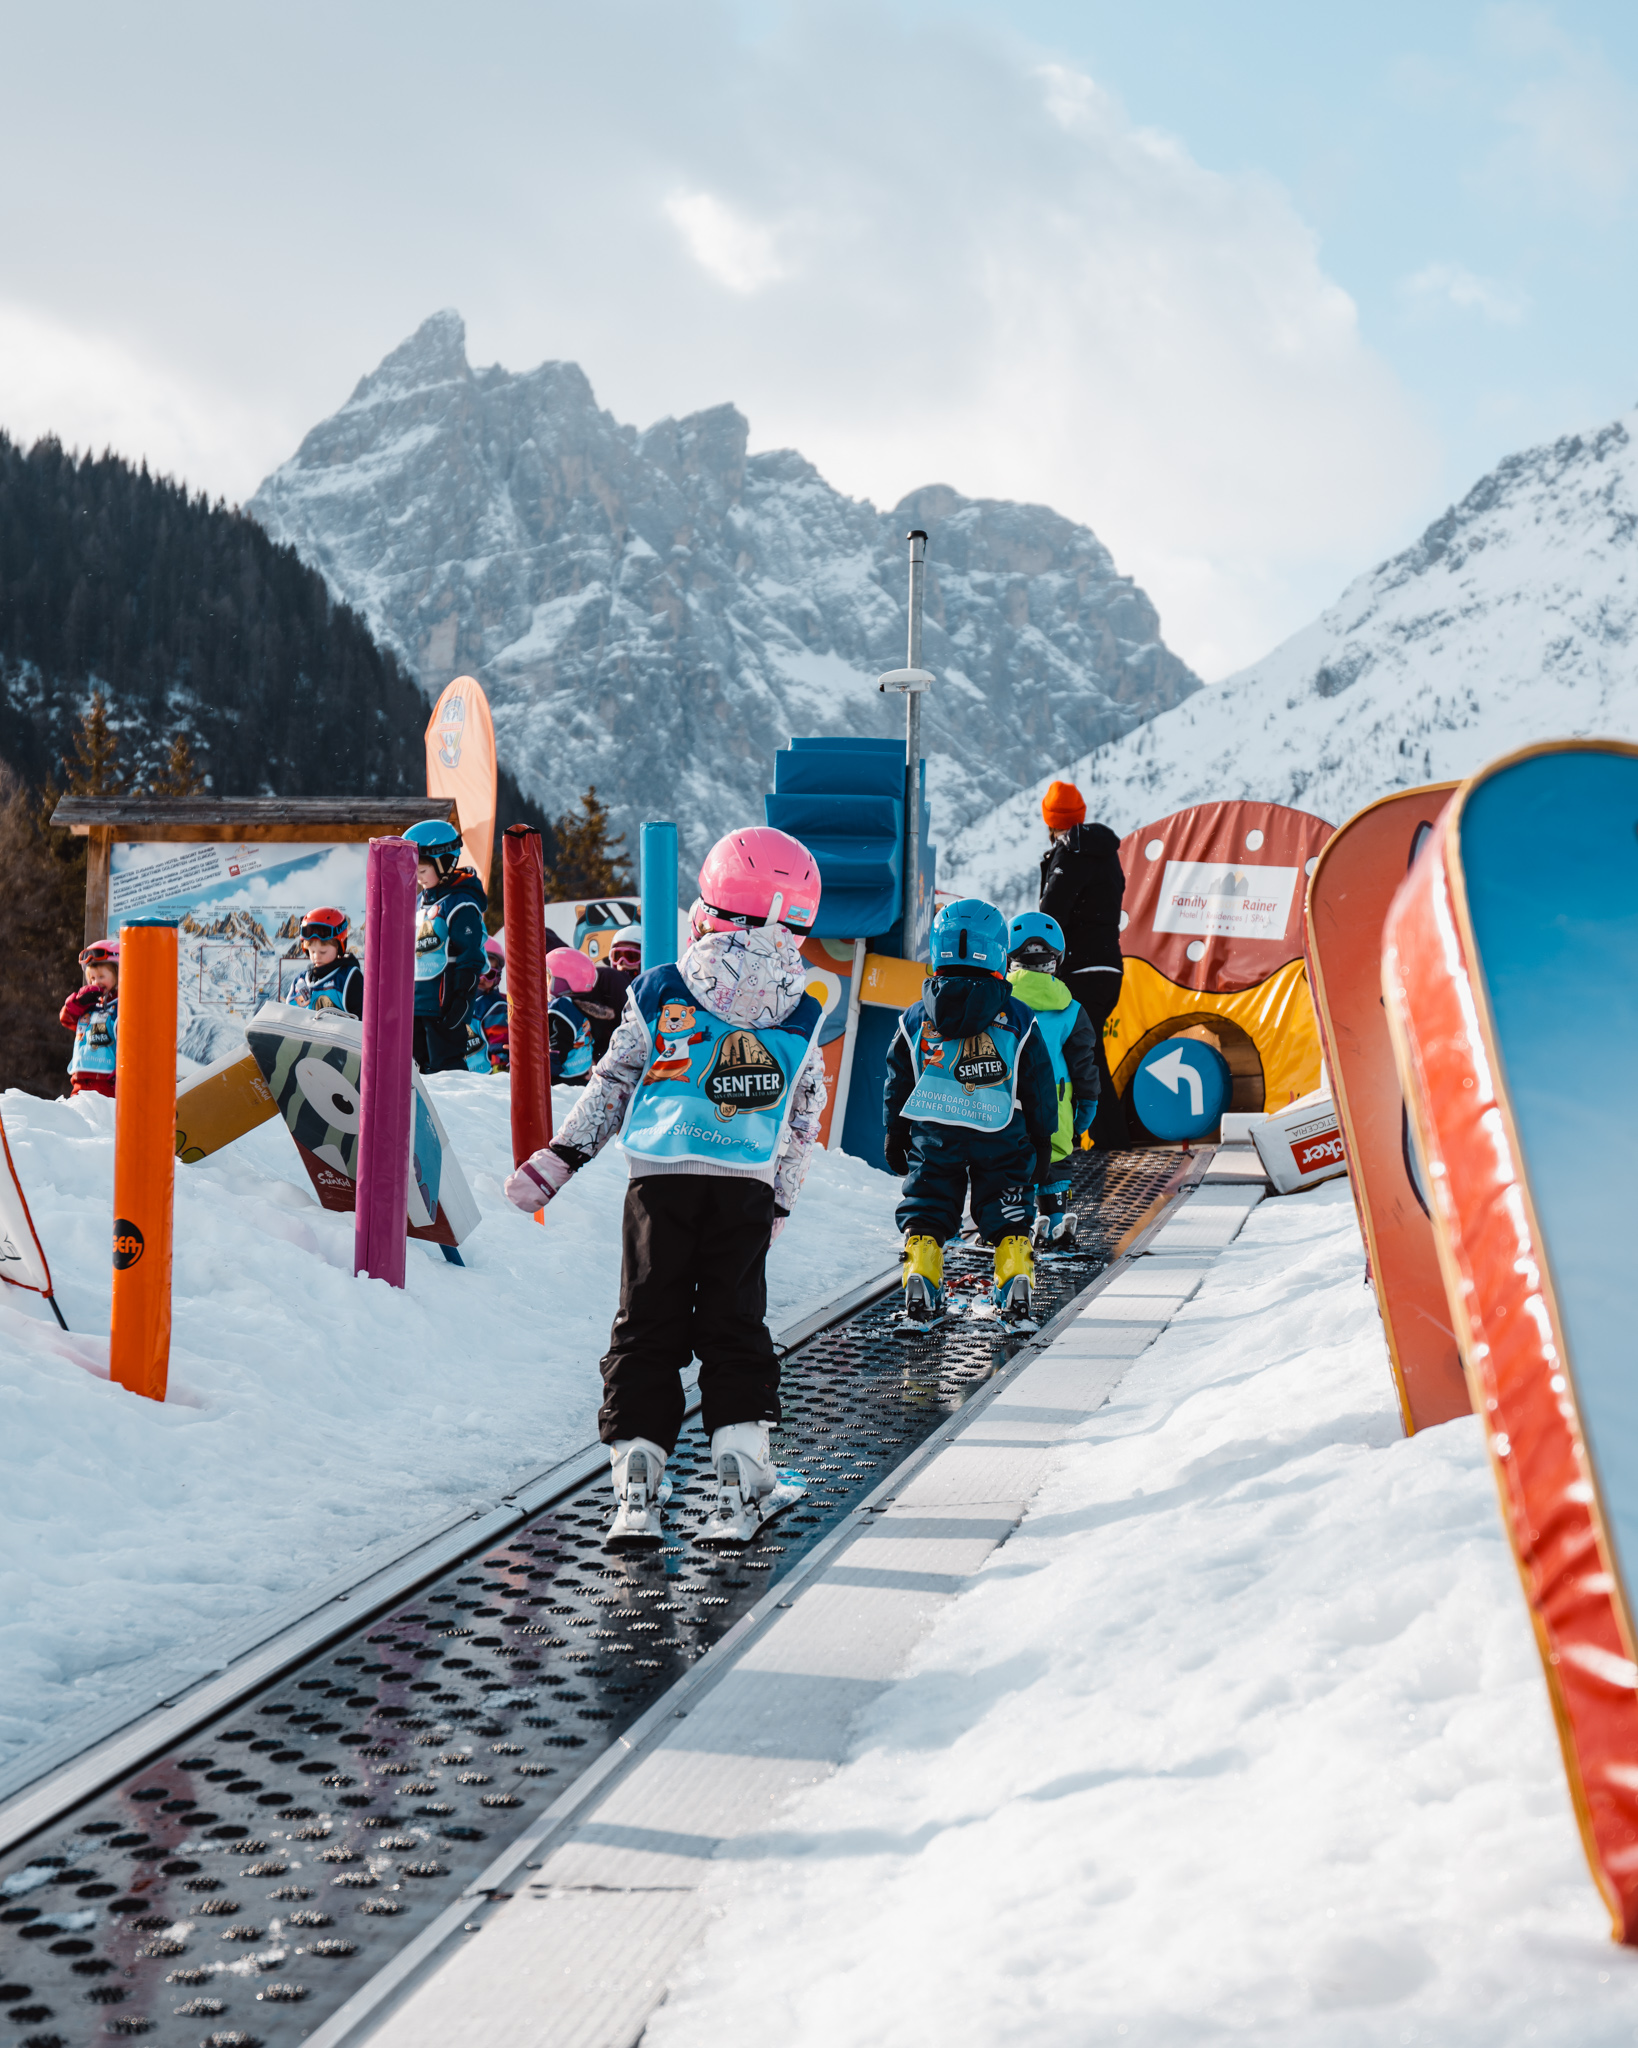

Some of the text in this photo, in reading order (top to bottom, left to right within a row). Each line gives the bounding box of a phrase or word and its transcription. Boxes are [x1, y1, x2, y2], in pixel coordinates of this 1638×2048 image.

[1242, 899, 1277, 912] Rainer
[958, 1060, 1003, 1078] SENFTER
[712, 1073, 780, 1097] SENFTER
[945, 1104, 993, 1122] DOLOMITEN
[971, 1101, 1002, 1114] SCHOOL
[1302, 1137, 1344, 1164] cker
